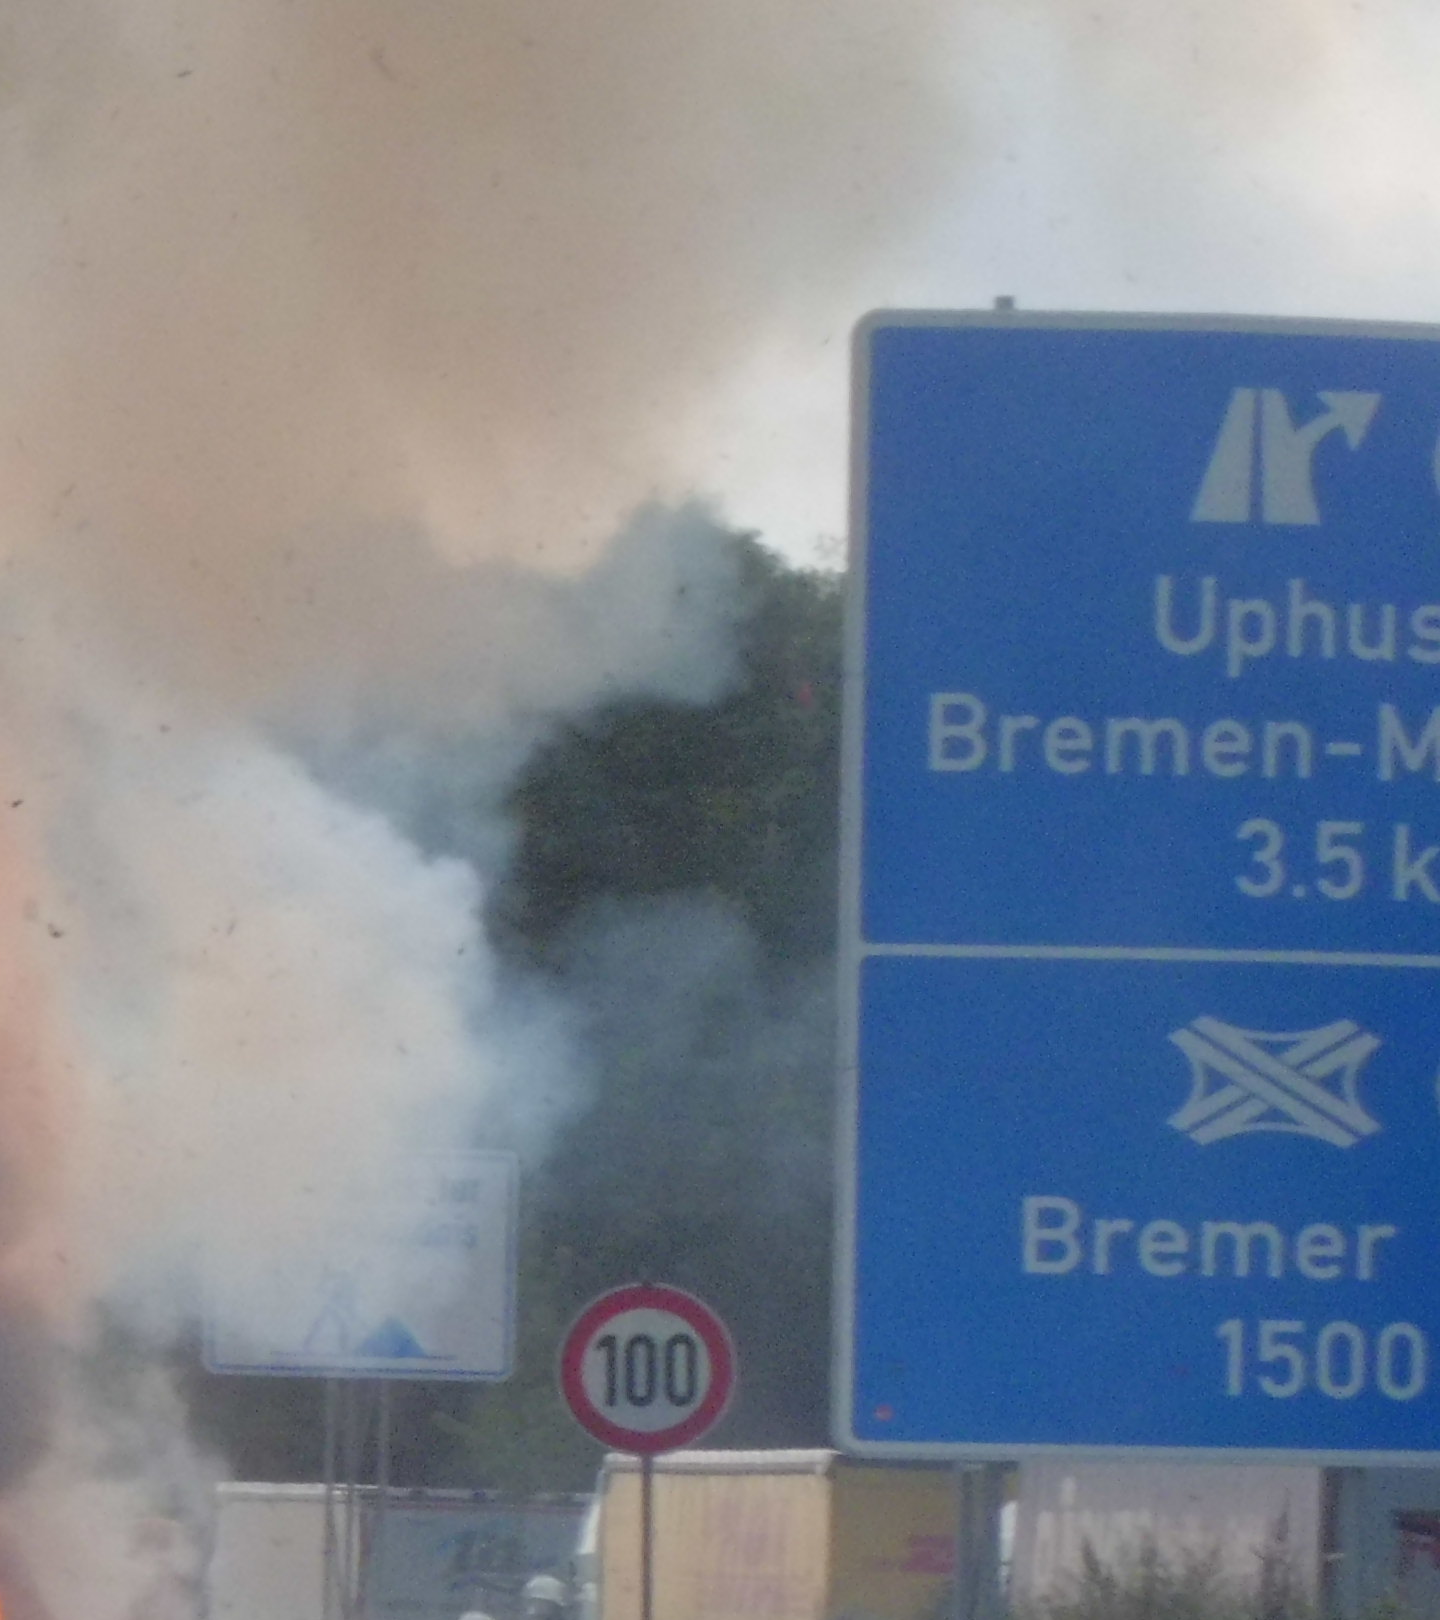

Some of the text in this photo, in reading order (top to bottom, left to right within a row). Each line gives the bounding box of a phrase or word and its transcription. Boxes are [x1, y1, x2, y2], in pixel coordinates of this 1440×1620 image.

[927, 691, 1440, 782] Bremen-M
[1234, 818, 1366, 900] 3.5
[1021, 1195, 1398, 1281] Bremer
[594, 1332, 699, 1408] 100
[1216, 1318, 1428, 1401] 1500
